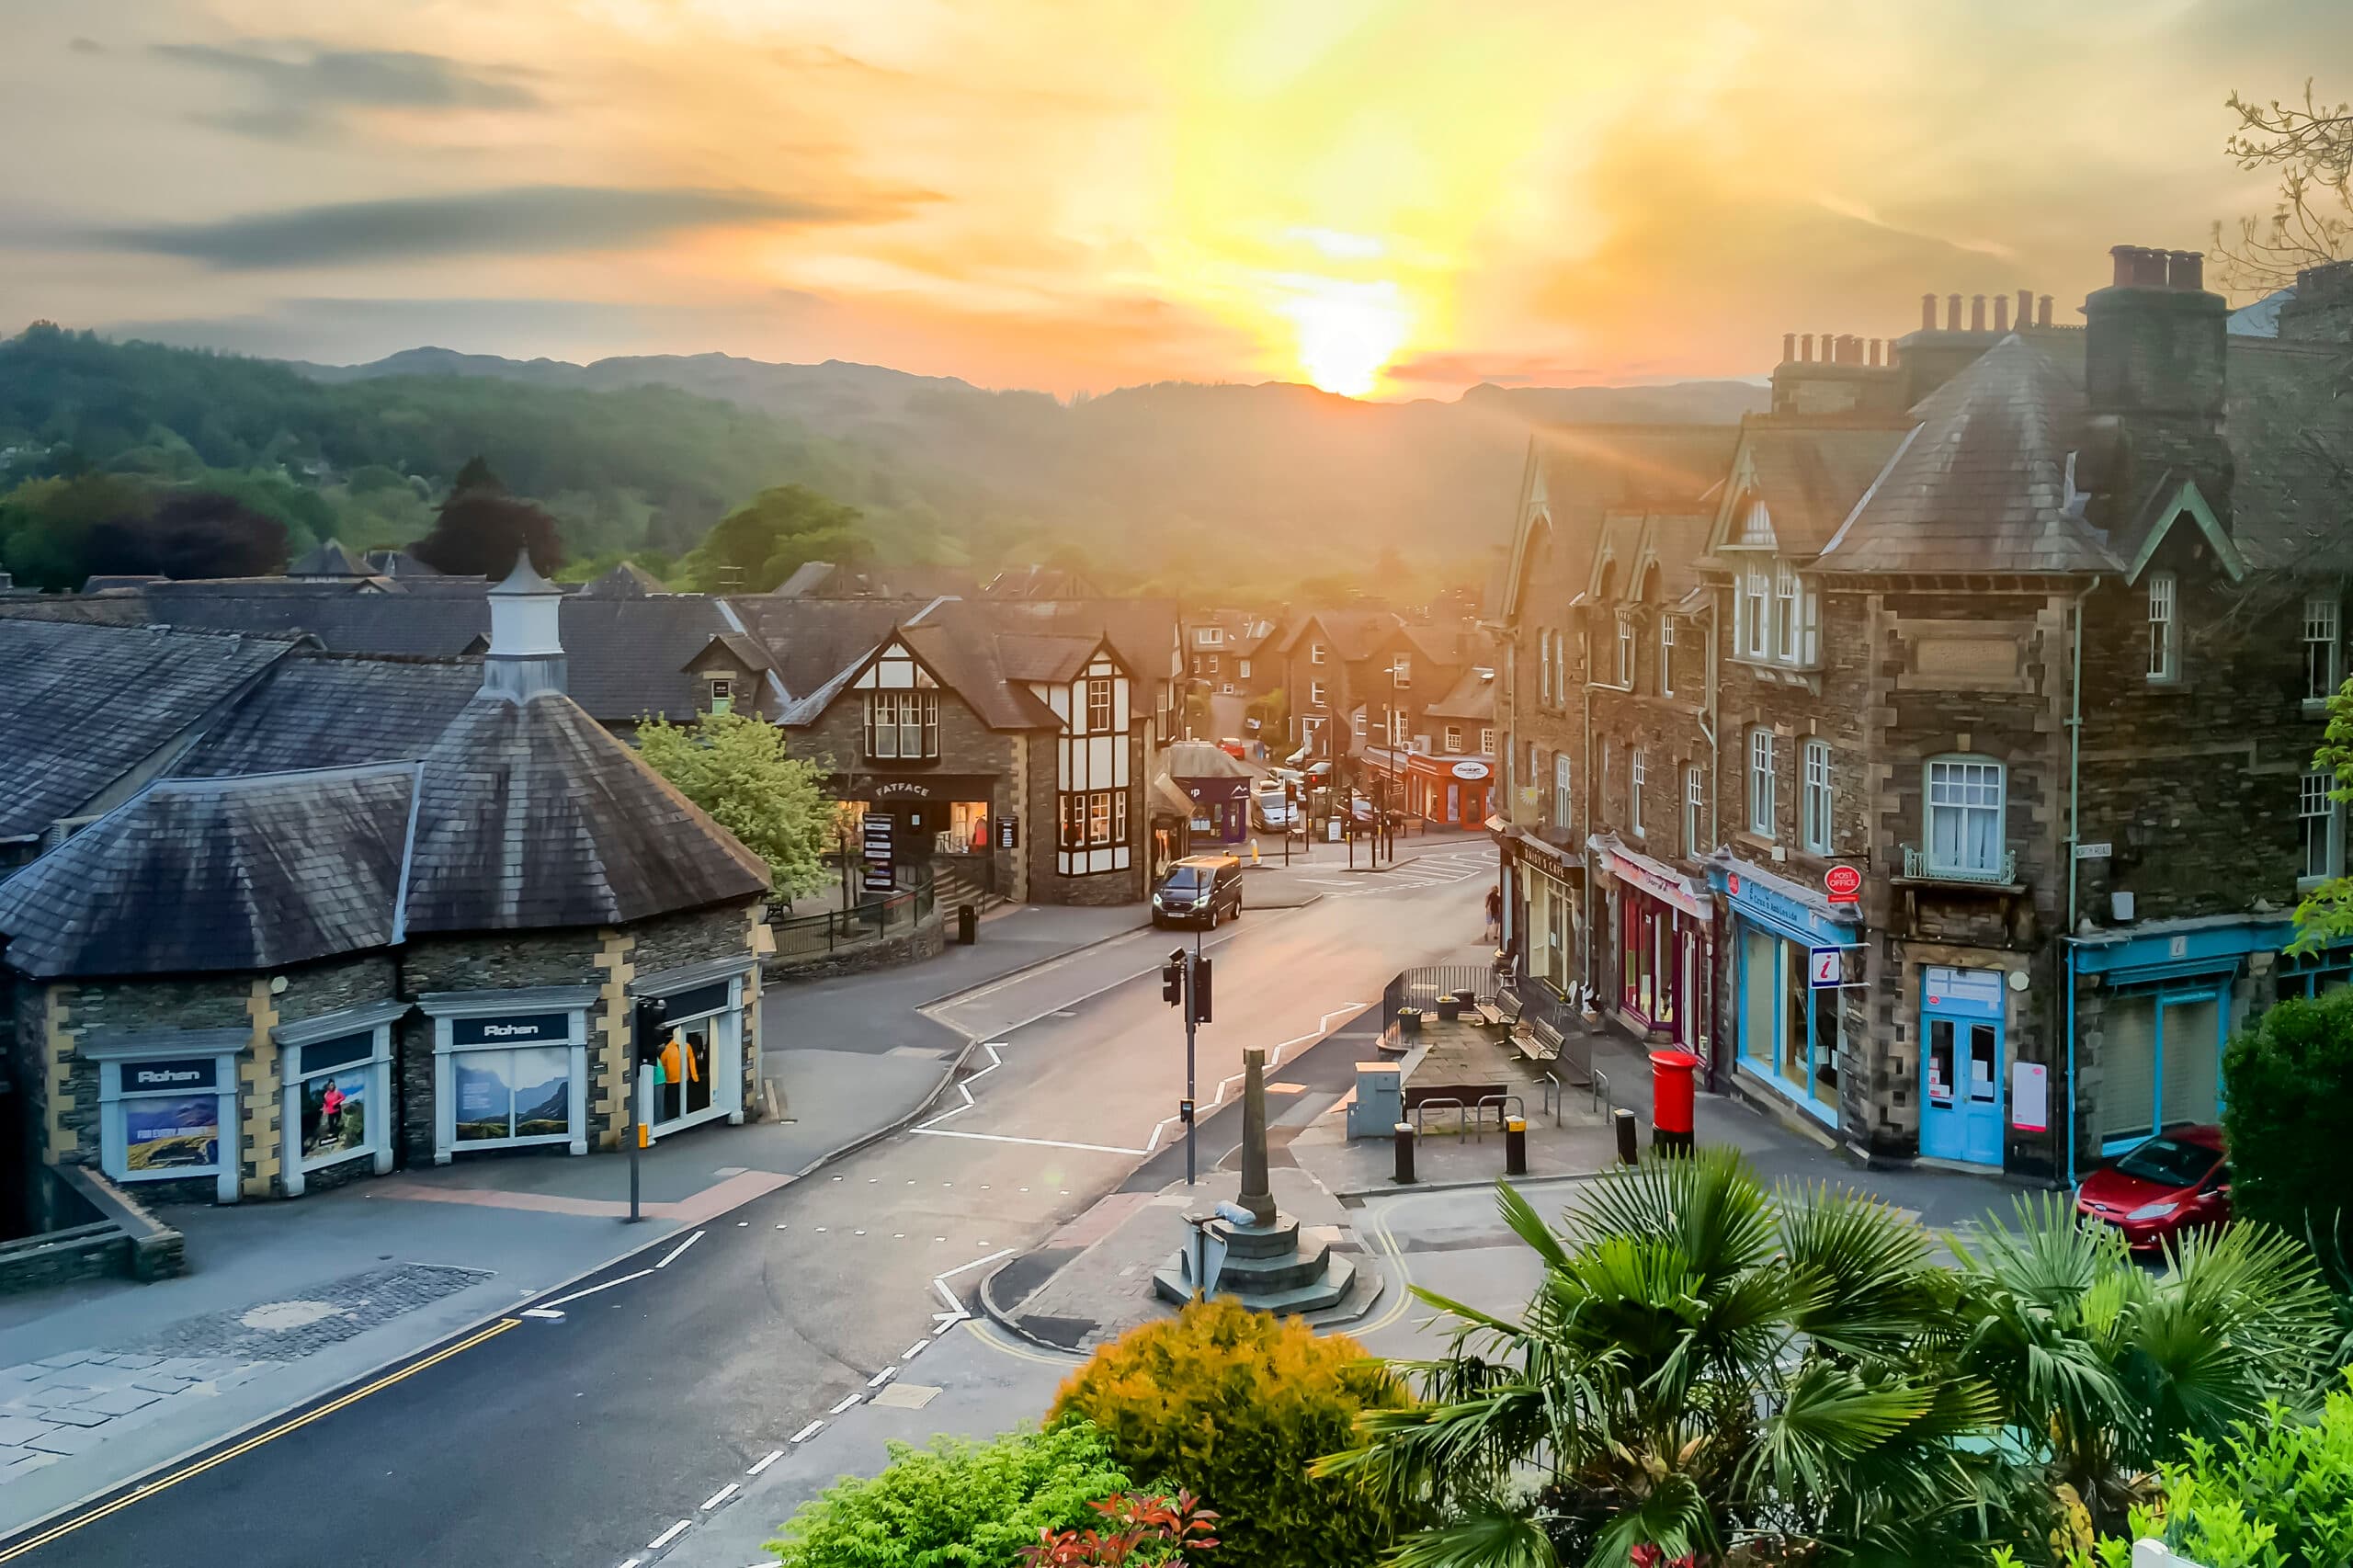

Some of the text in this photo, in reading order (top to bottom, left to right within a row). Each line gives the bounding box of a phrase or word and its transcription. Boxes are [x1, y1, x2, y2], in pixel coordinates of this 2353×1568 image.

[876, 782, 929, 797] FATFACE
[1834, 871, 1853, 880] POST
[1829, 880, 1857, 888] OFFICE
[483, 1024, 539, 1037] Rohan
[138, 1069, 200, 1084] Rohan
